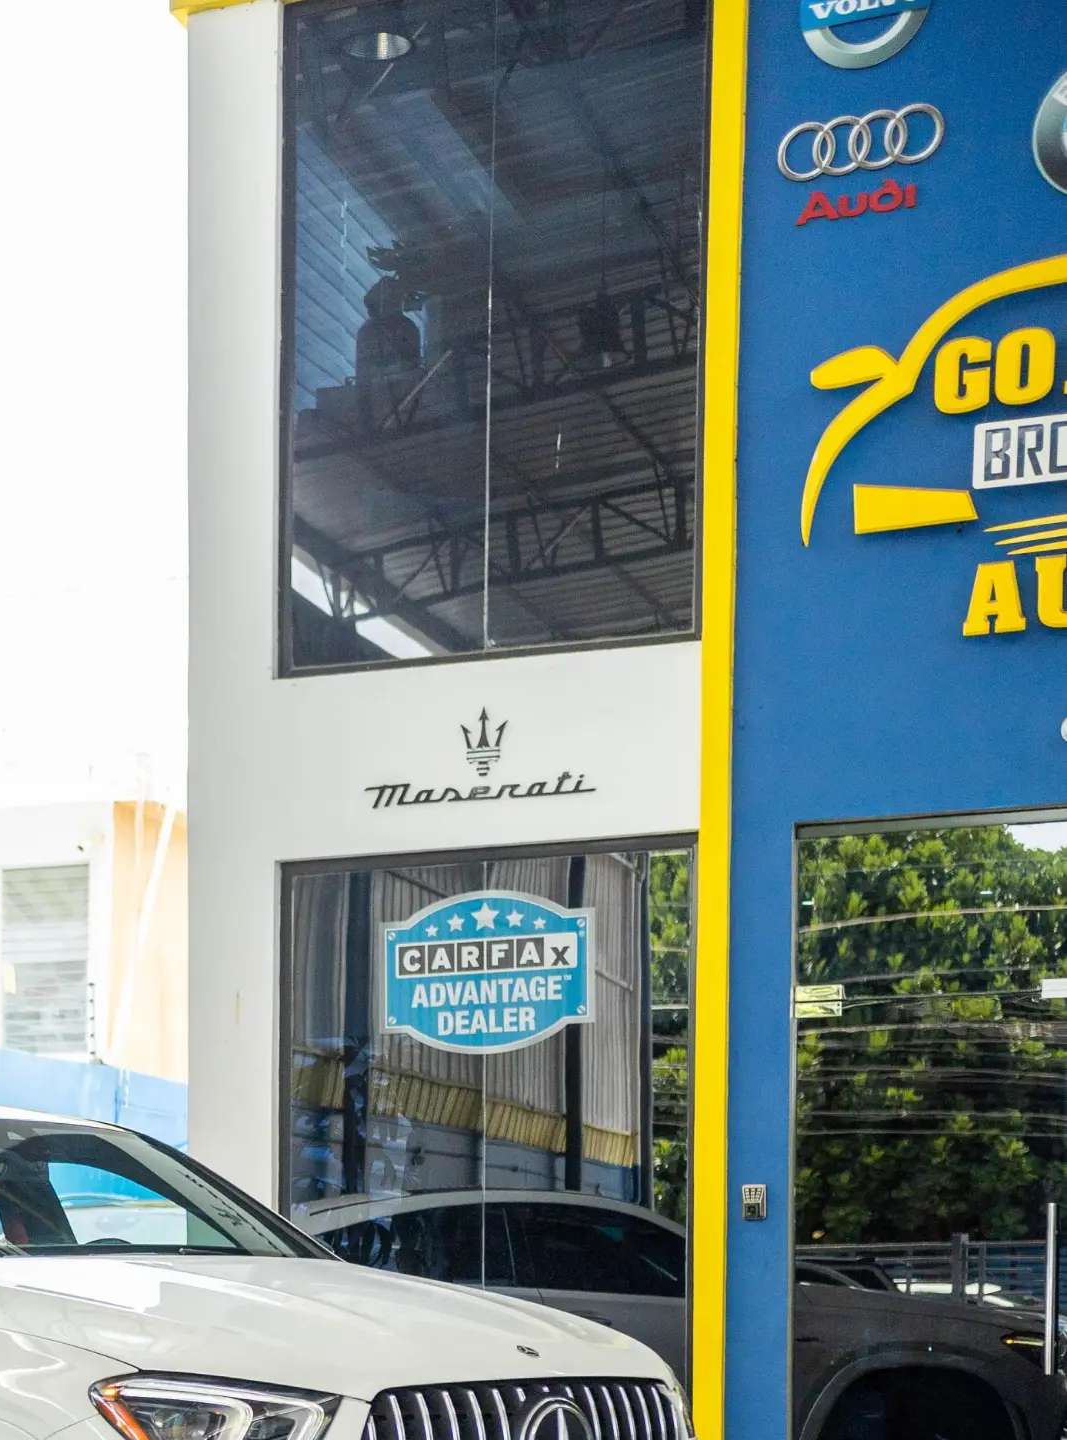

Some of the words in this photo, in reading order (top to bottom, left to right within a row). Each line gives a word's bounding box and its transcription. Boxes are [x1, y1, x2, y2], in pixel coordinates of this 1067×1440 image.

[809, 0, 914, 19] VOL
[796, 178, 918, 225] Audi
[934, 327, 1067, 414] GO
[364, 771, 597, 809] Maserati
[402, 940, 571, 973] CARFAX
[437, 1006, 536, 1036] DEALER
